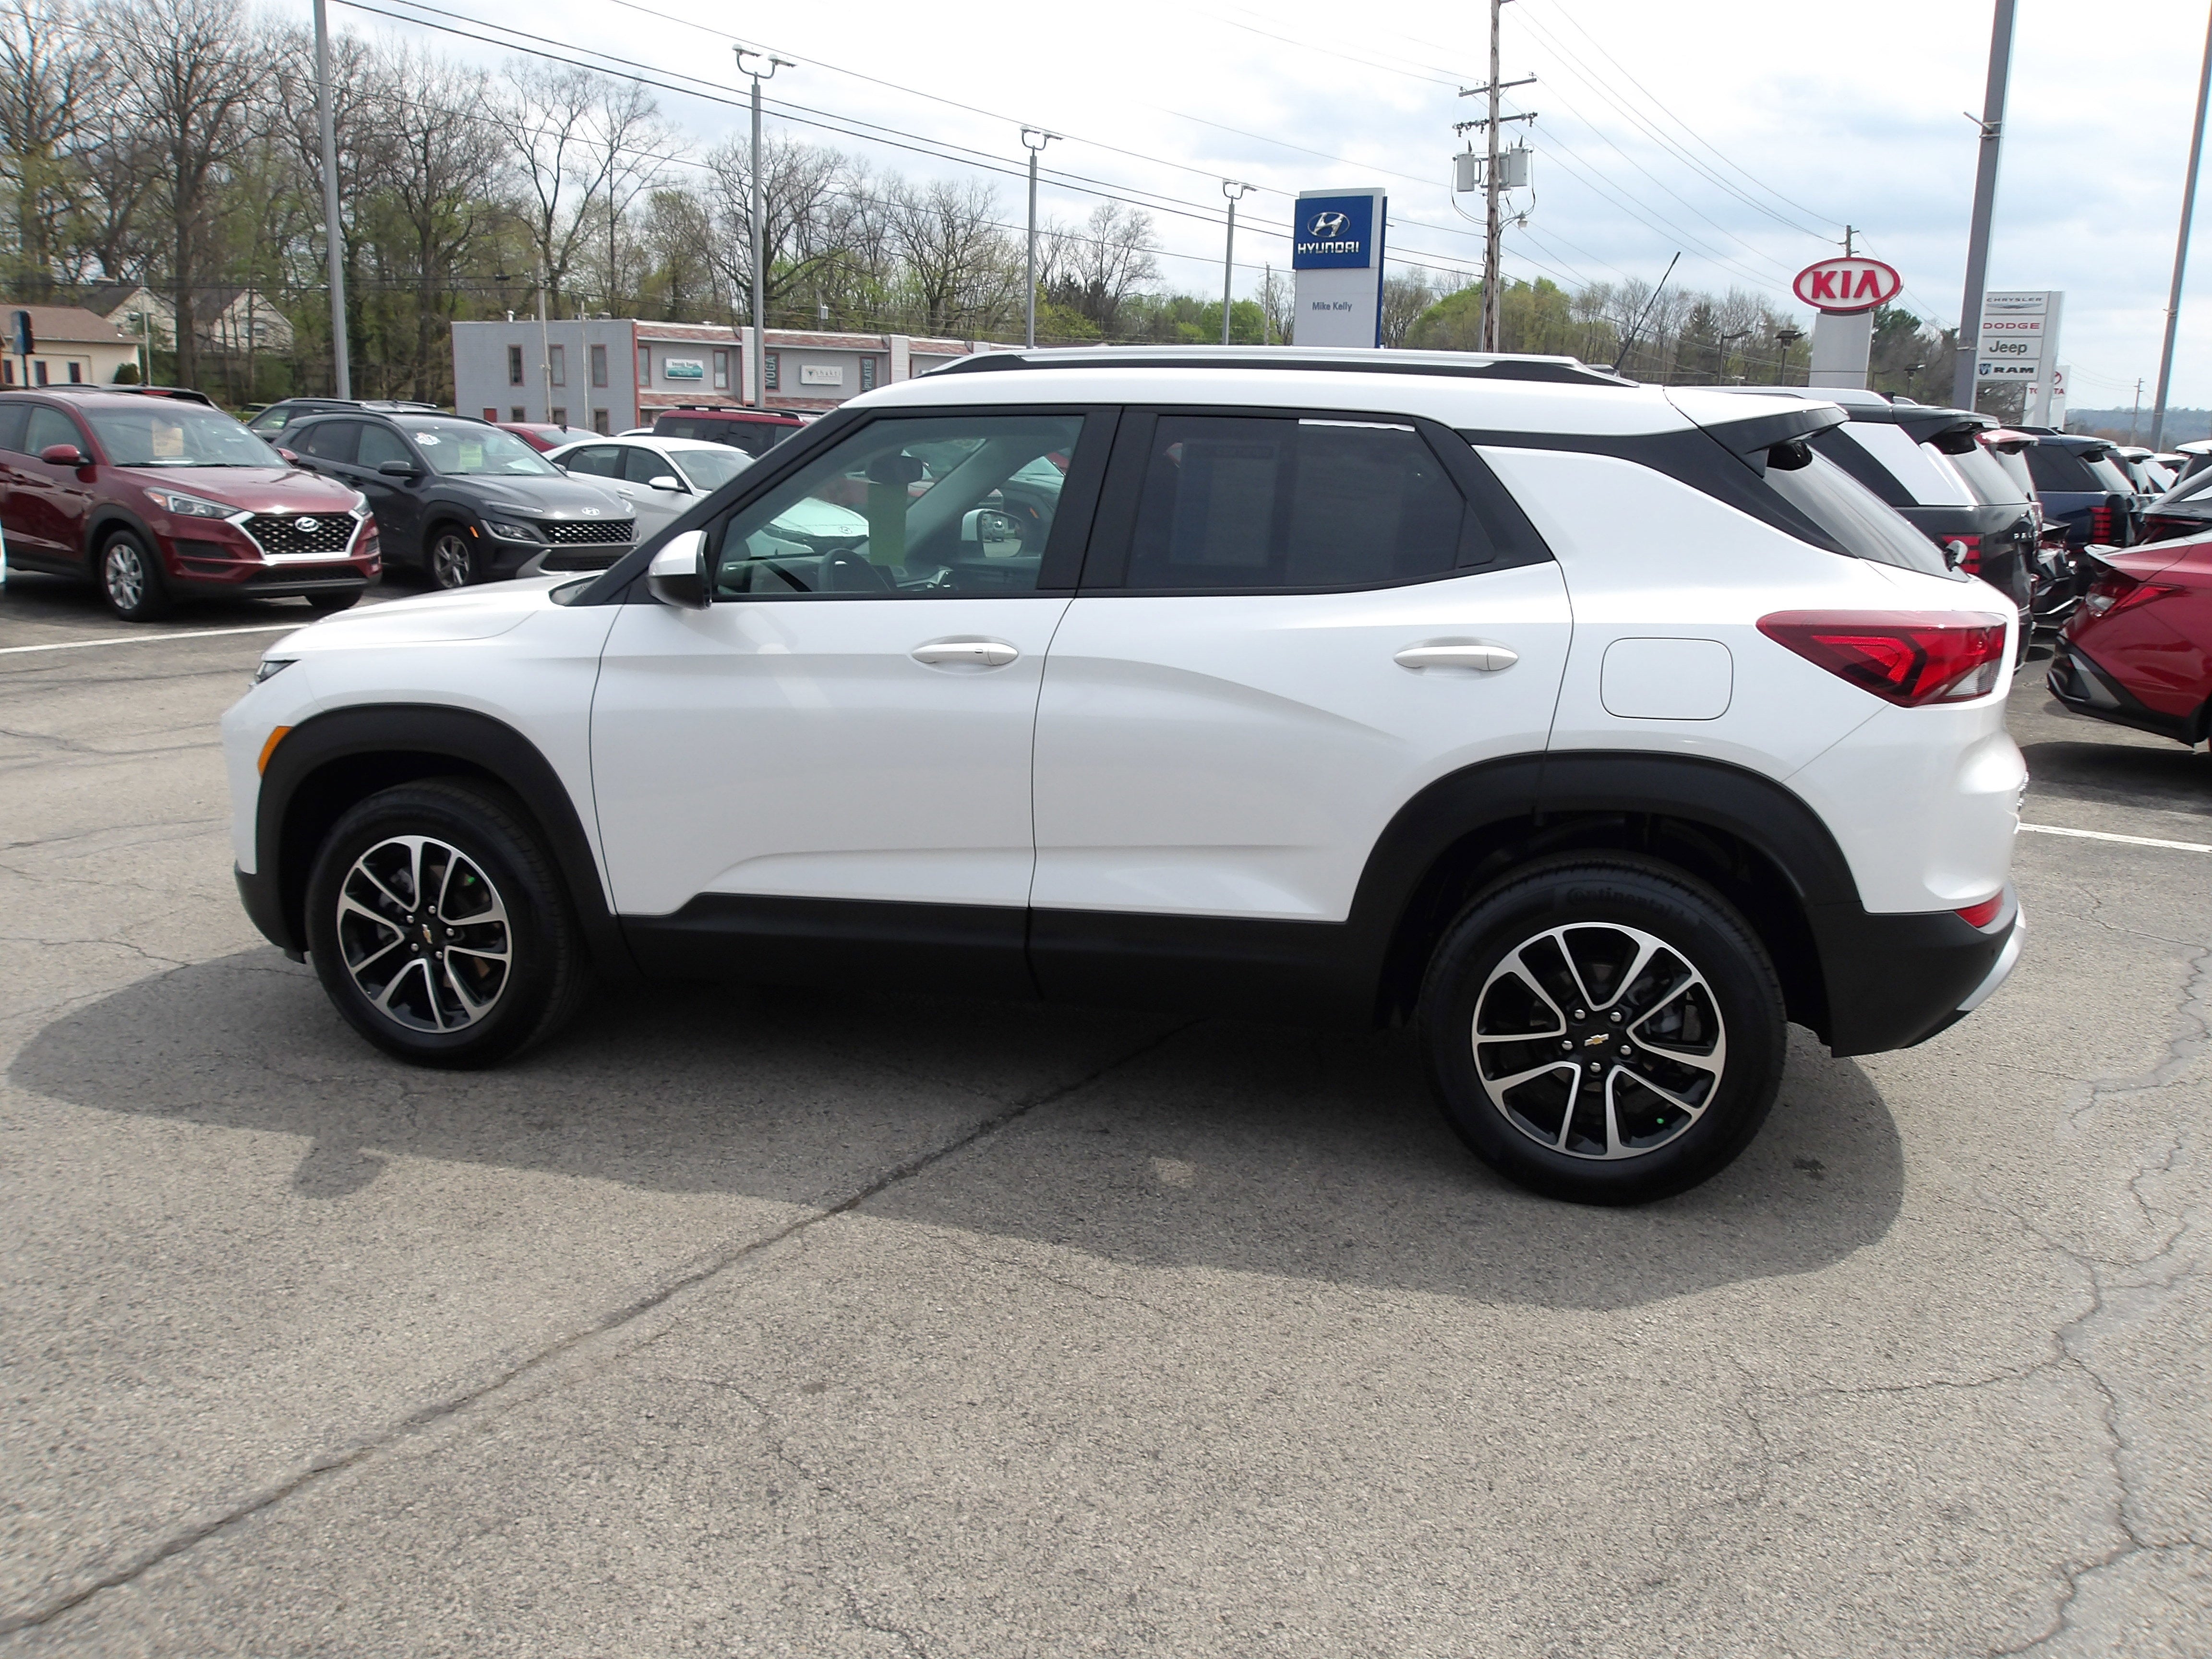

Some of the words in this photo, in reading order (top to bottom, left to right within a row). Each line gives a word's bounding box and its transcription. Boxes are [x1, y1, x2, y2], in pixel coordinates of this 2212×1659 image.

[1298, 241, 1359, 254] HYUNDAI
[1812, 270, 1881, 299] KIA
[1312, 301, 1331, 311] Mike
[1333, 301, 1352, 312] Kelly
[1989, 340, 2027, 355] Jeep
[765, 357, 776, 386] YOGA
